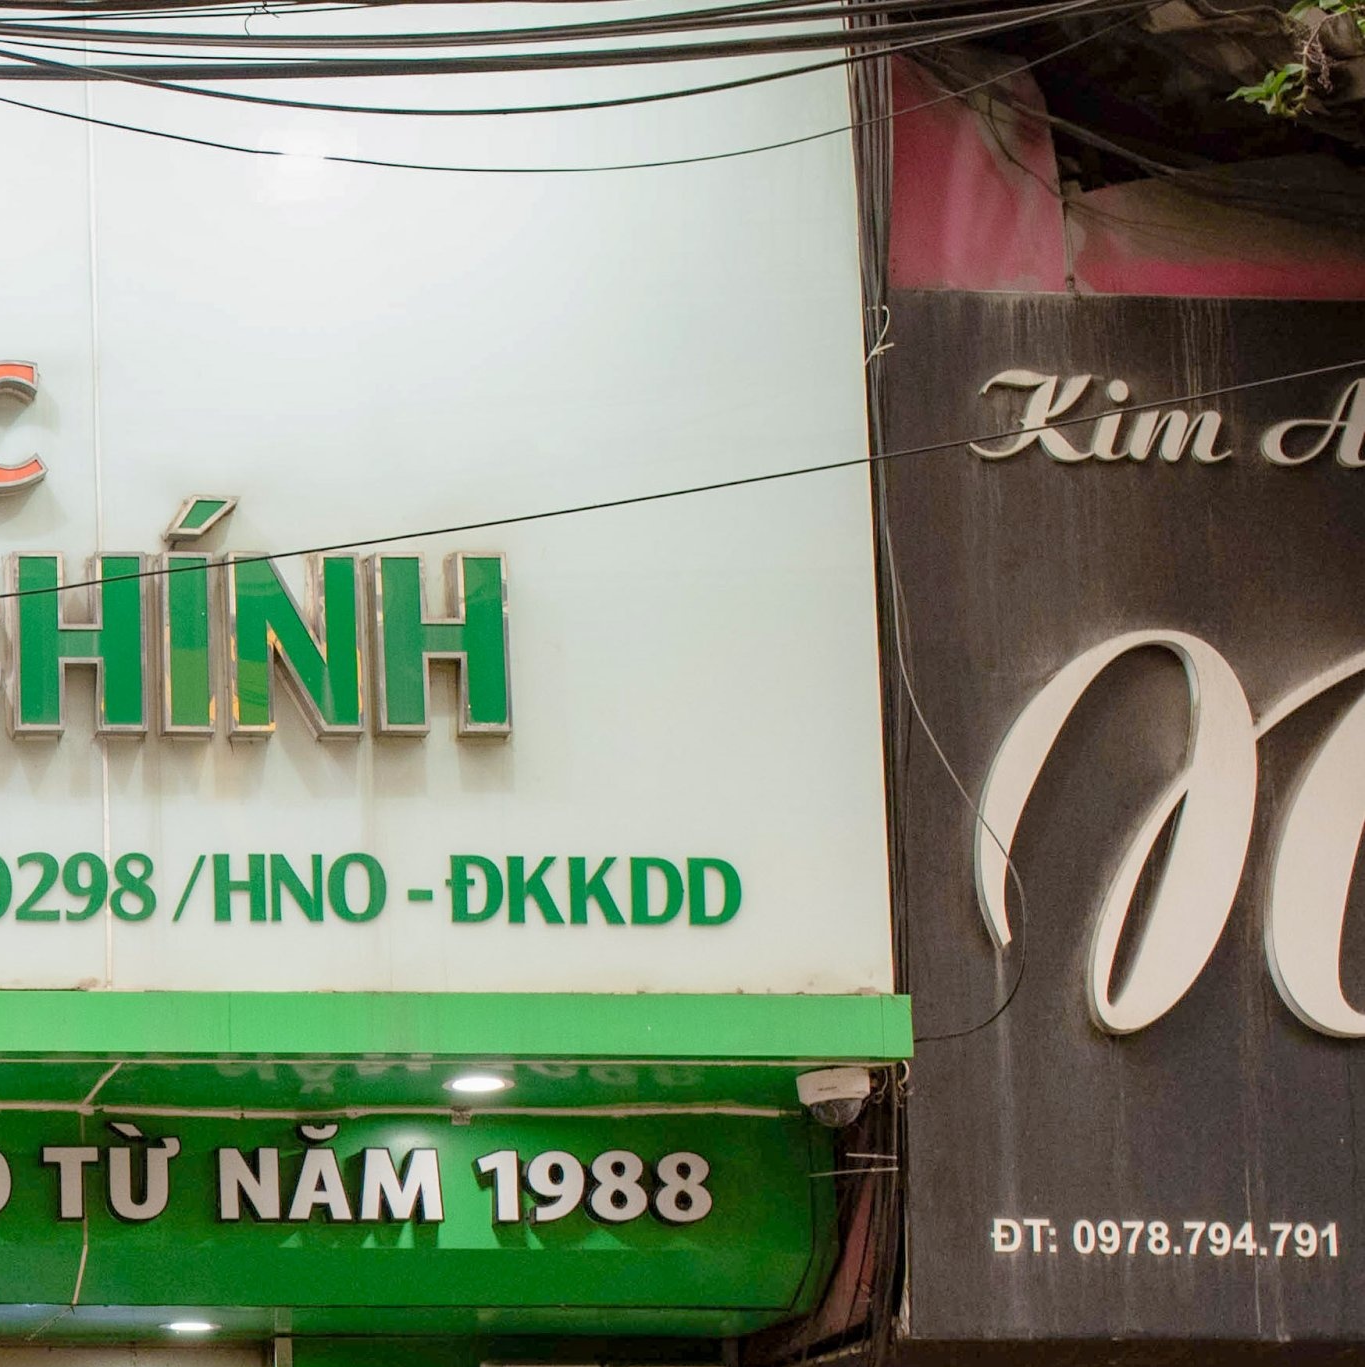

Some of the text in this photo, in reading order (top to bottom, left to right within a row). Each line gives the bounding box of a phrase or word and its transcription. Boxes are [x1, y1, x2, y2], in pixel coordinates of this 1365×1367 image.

[967, 370, 1231, 465] Kim
[39, 1121, 182, 1223] TỪ
[216, 1123, 446, 1224] NĂM
[474, 1148, 714, 1226] 1988
[989, 1217, 1341, 1259] ĐT: 0978.794.791
